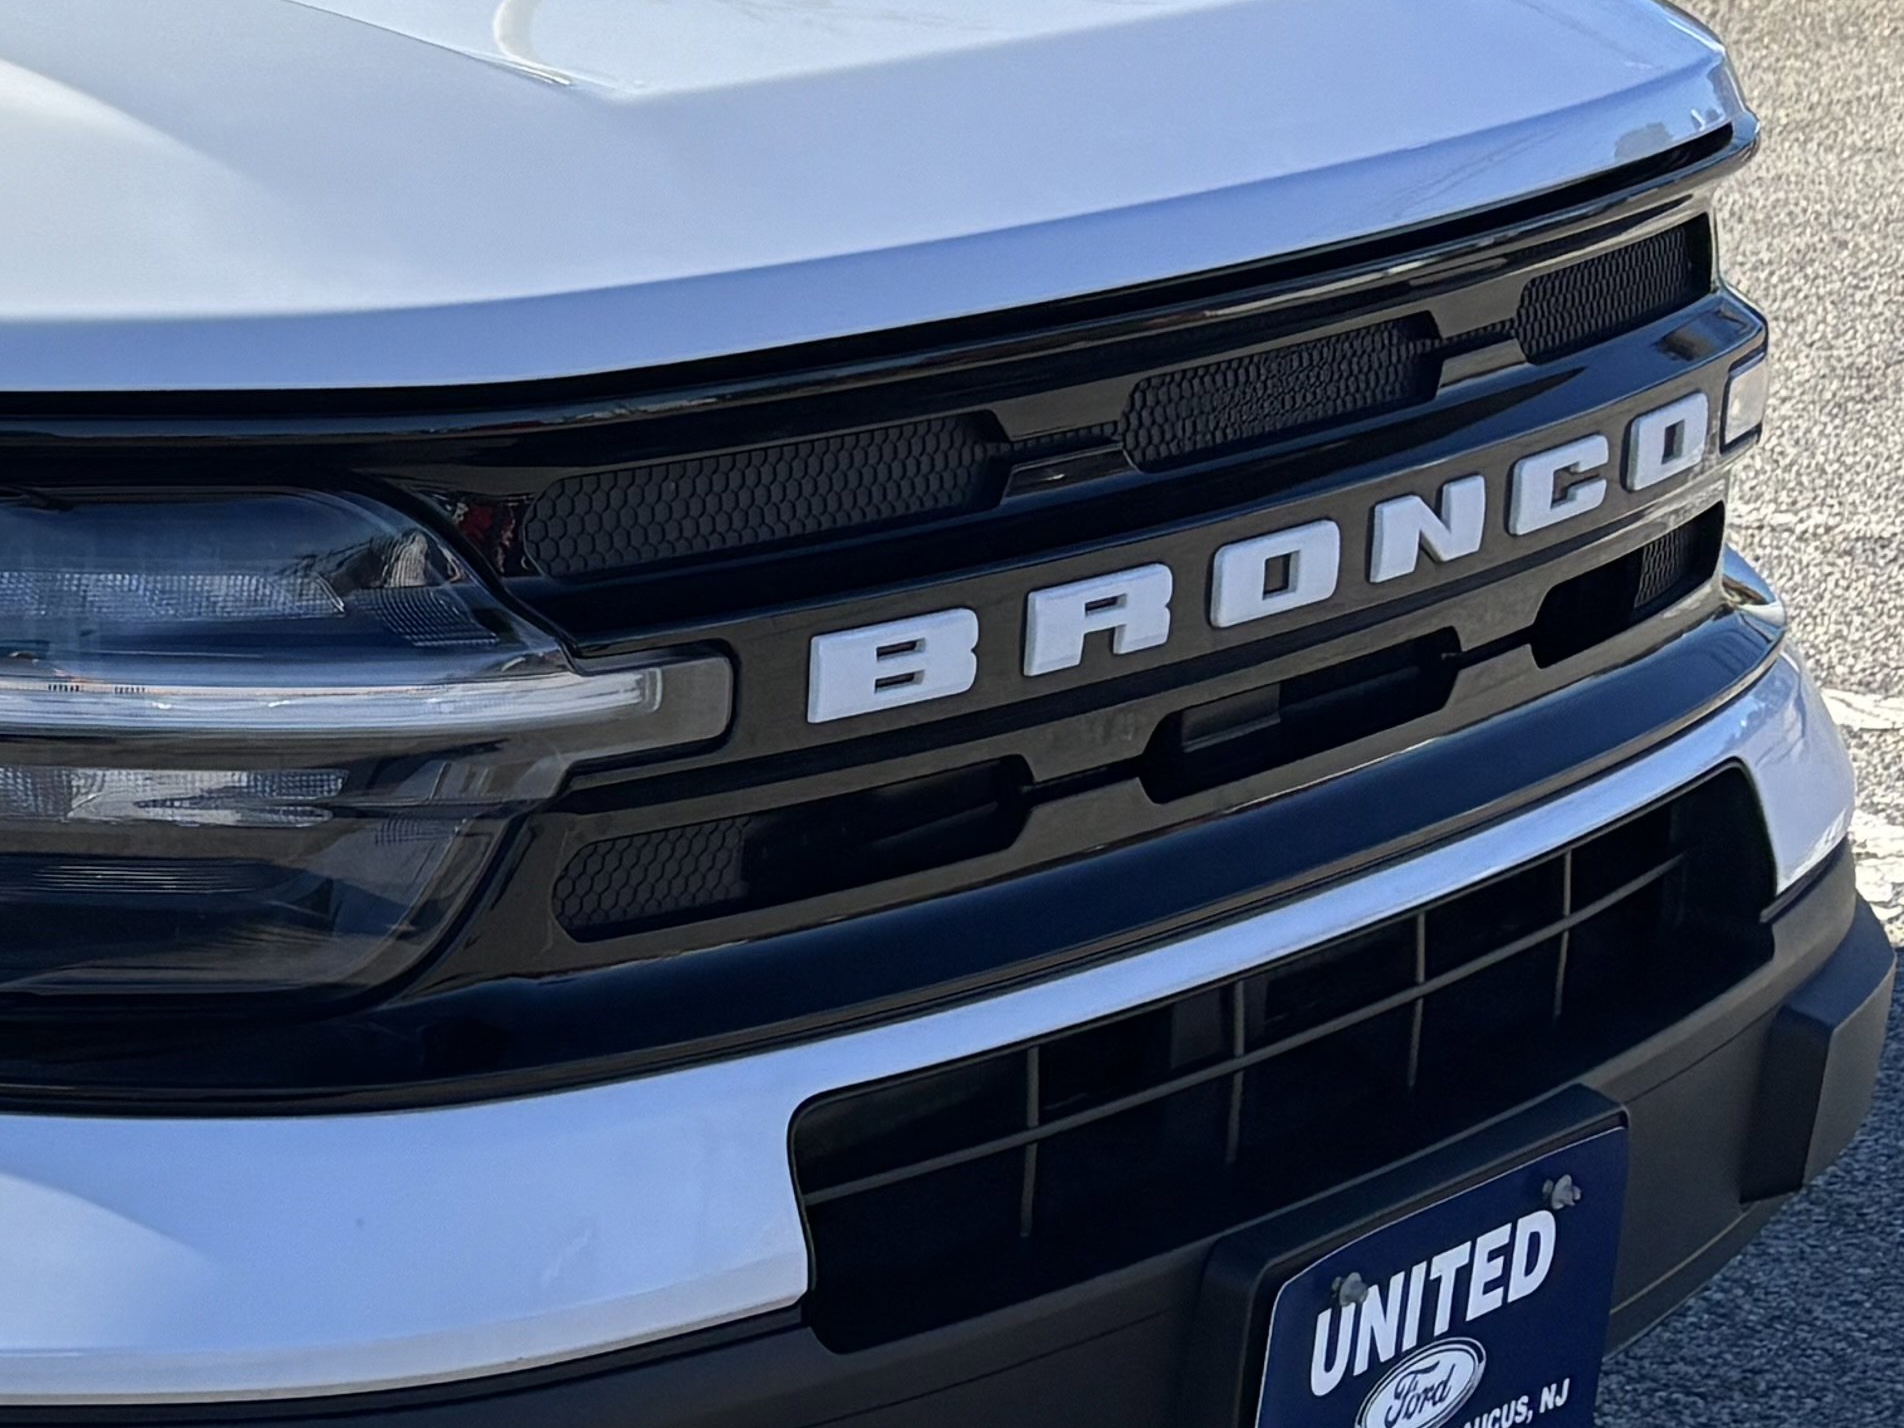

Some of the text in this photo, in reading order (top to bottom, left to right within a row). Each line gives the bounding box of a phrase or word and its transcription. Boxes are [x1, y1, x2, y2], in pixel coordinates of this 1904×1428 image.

[805, 390, 1710, 724] BRONCO
[1309, 1208, 1558, 1397] UNITED
[1539, 1378, 1571, 1414] NJ
